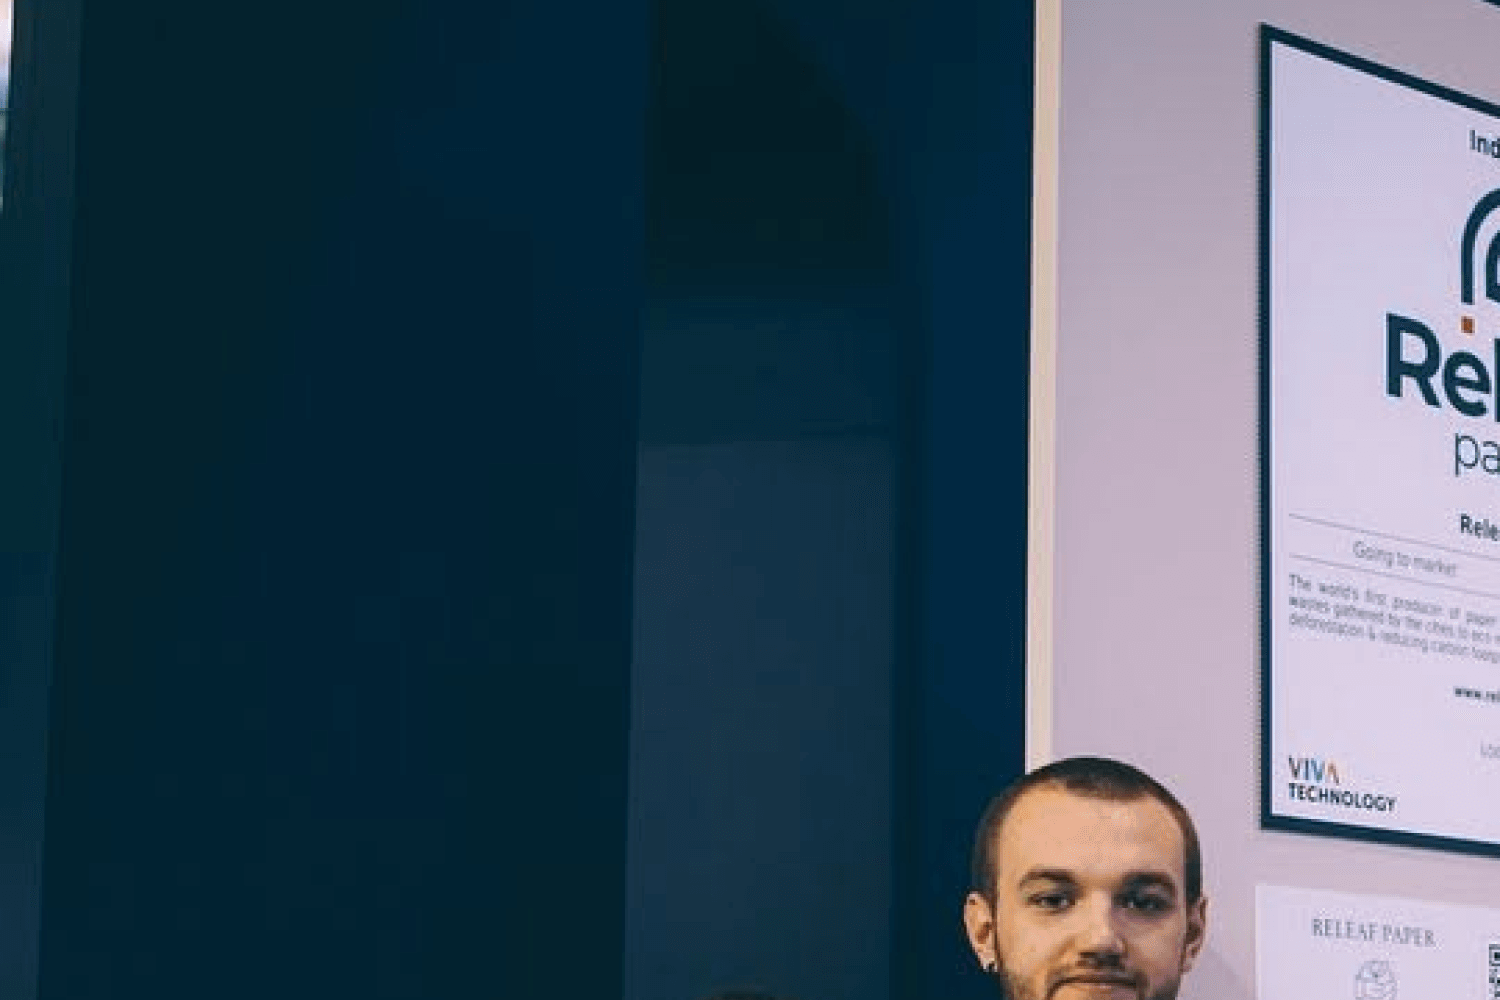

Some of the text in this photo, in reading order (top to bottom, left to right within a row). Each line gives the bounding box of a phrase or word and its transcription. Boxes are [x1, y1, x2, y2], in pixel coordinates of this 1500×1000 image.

[1353, 540, 1457, 576] Going to market
[1289, 755, 1340, 784] VIVA
[1289, 782, 1396, 813] TECHNOLOGY
[1314, 918, 1437, 946] RELEAF PAPER
